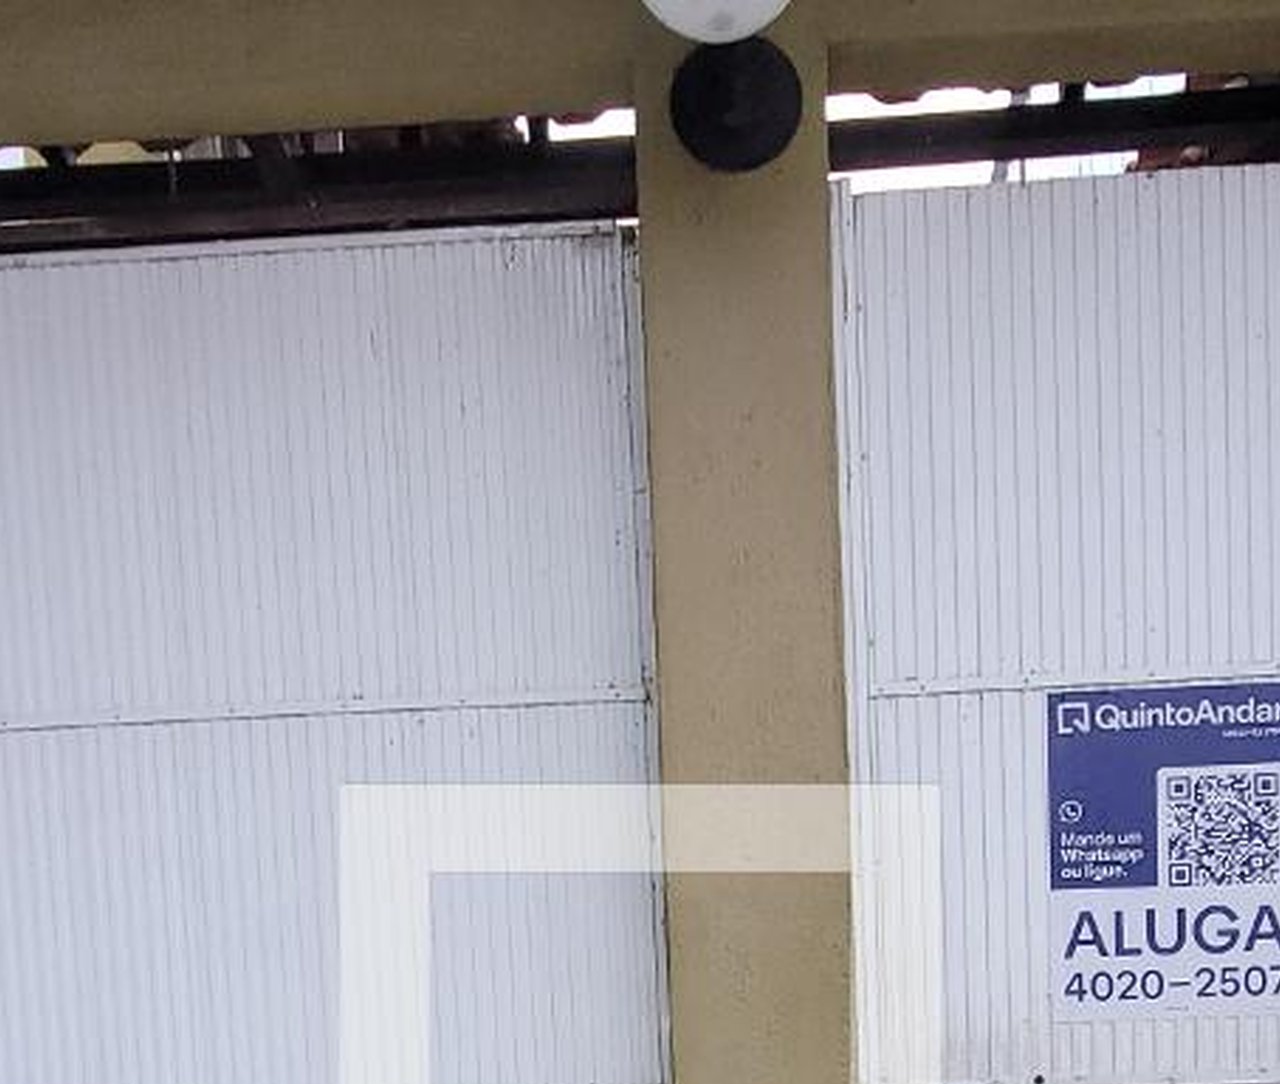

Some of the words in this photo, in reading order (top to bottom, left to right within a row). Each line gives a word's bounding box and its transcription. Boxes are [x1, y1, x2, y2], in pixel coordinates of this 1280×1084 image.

[1061, 831, 1115, 847] Mande
[1117, 832, 1142, 845] um
[1061, 867, 1082, 879] ou
